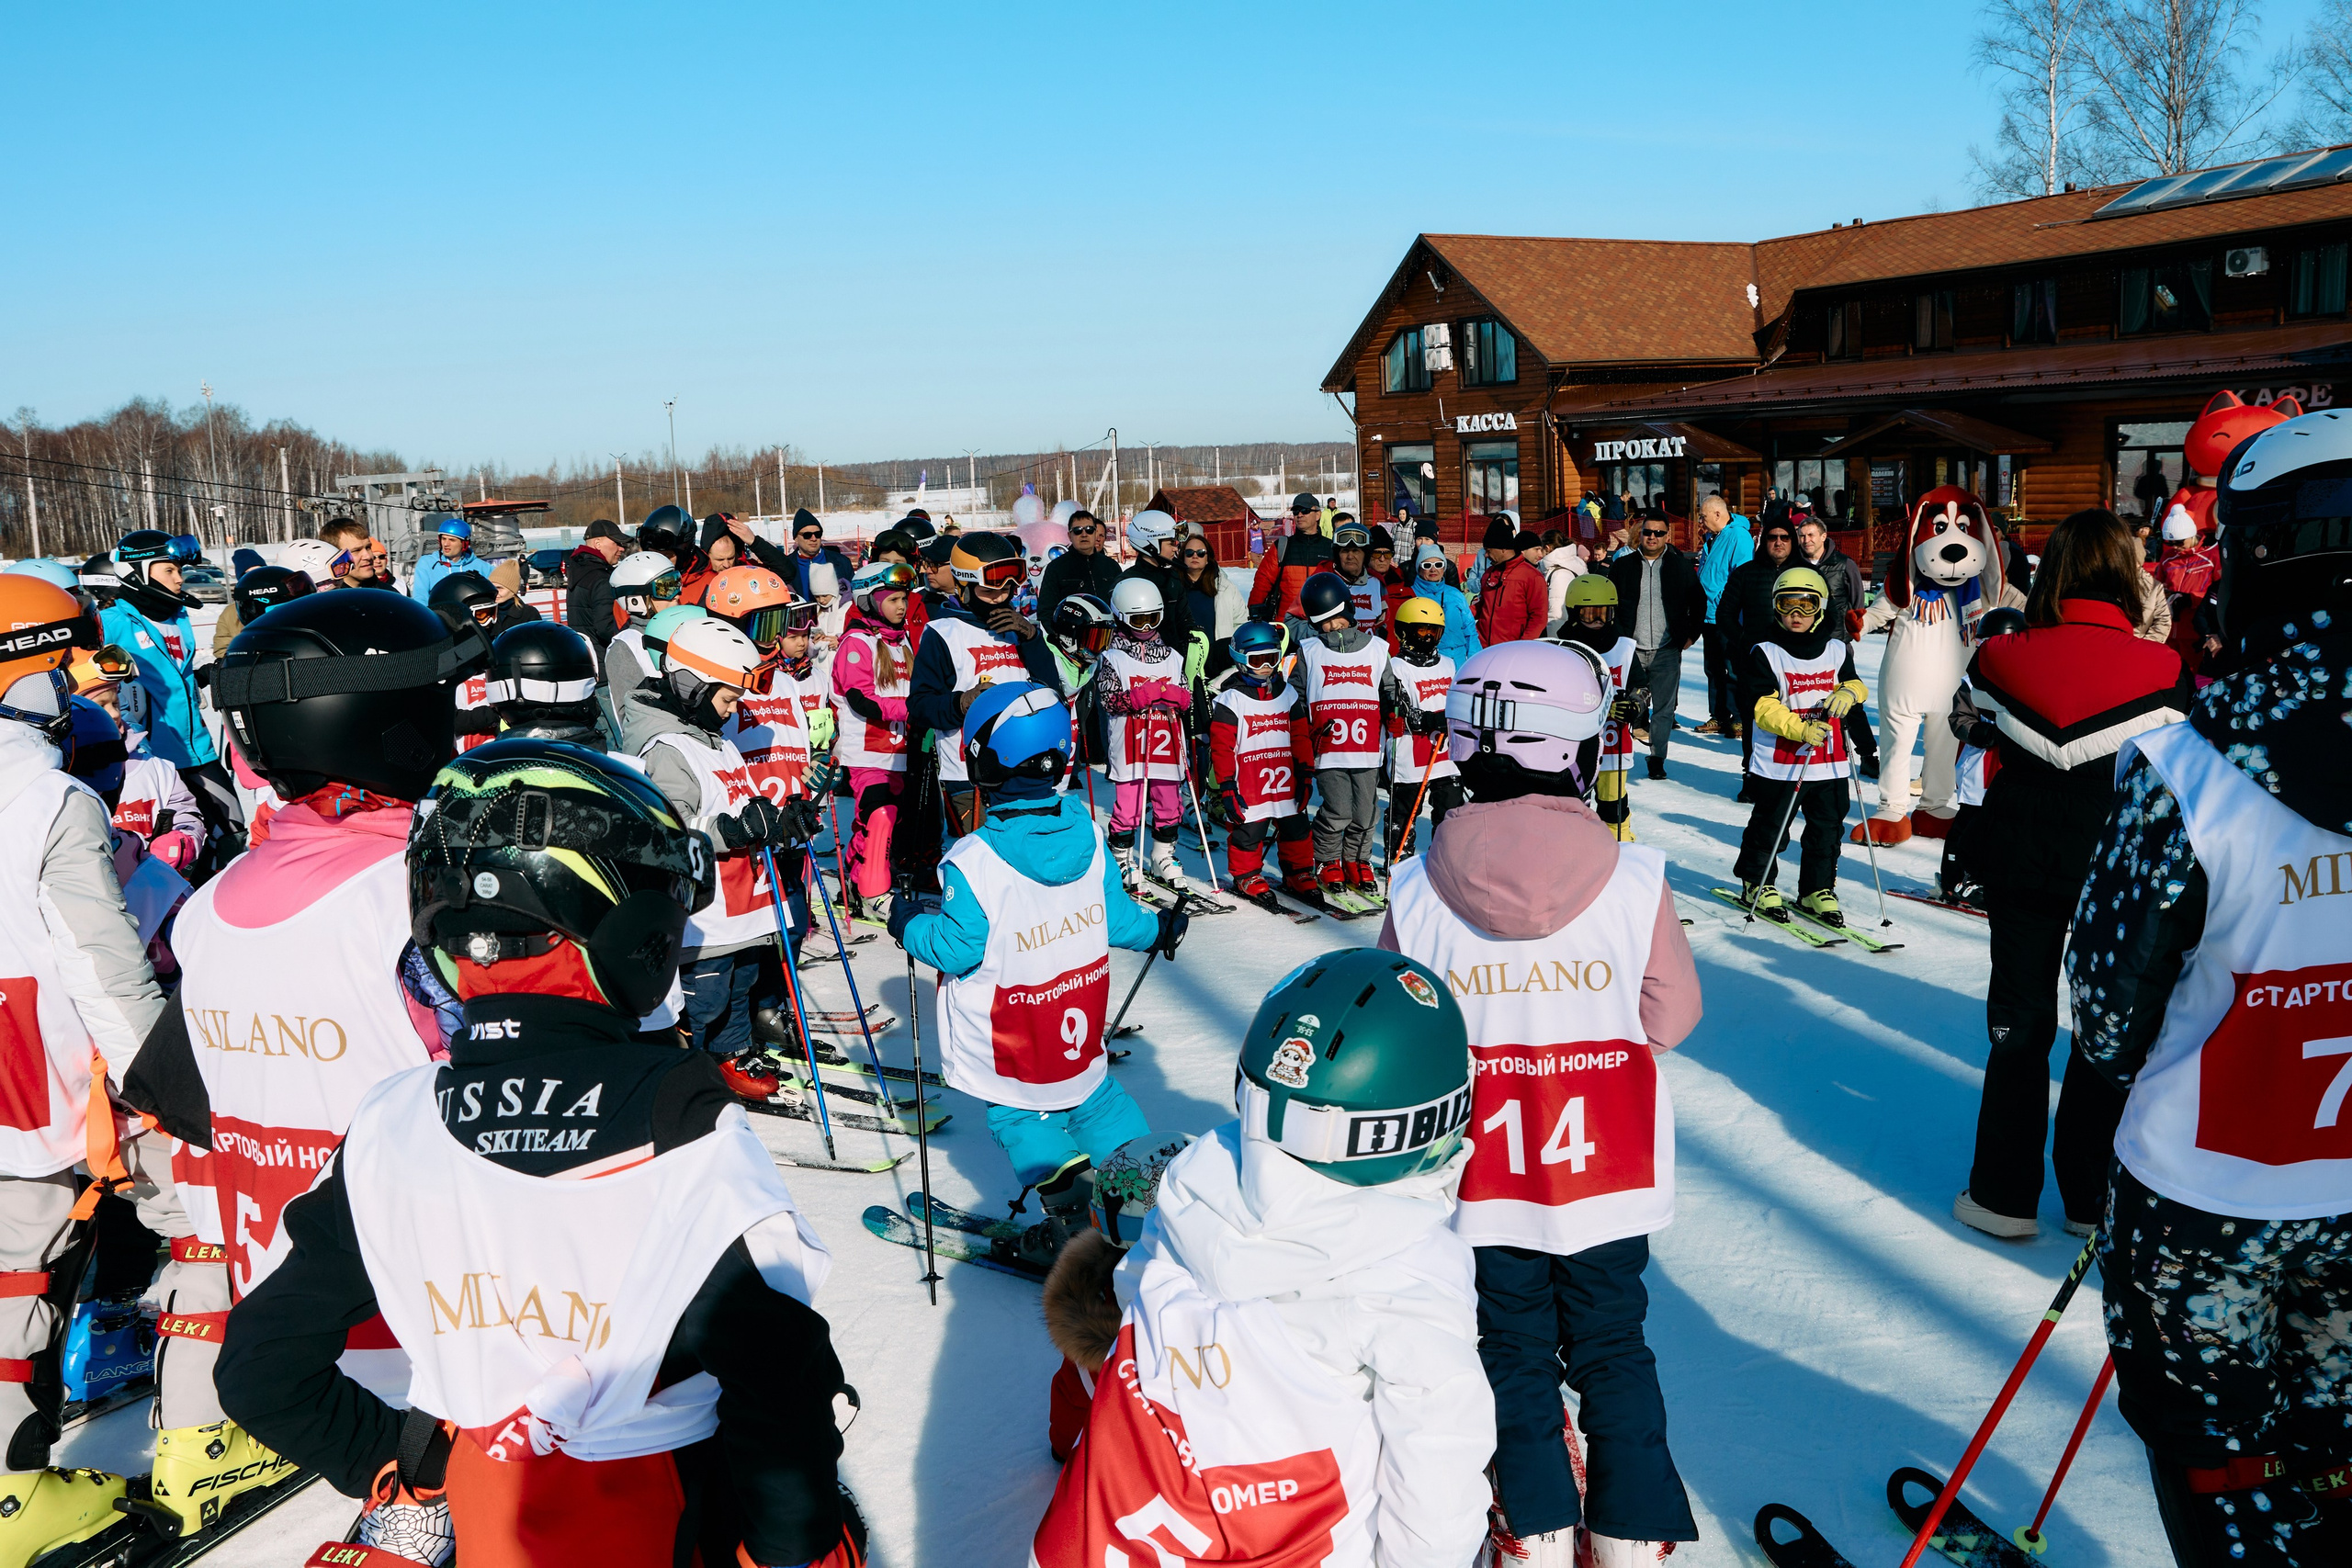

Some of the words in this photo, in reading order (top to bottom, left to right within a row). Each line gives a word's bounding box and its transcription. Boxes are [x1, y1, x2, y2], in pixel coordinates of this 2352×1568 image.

[1456, 412, 1517, 434] КАССА
[1594, 436, 1687, 461] ПРОКАТ
[125, 551, 155, 559] HEAD
[249, 586, 278, 596] HEAD
[979, 651, 1005, 665] Альфа
[1328, 671, 1351, 681] Альфа
[1351, 671, 1368, 679] Банк
[1792, 679, 1815, 689] Альфа
[1815, 677, 1834, 685] Банк
[1316, 702, 1359, 712] СТАРТОВЫЙ
[1252, 718, 1274, 730] Альфа
[1273, 717, 1288, 726] Банк
[1330, 717, 1368, 745] 96
[1136, 728, 1171, 756] 12
[1243, 750, 1282, 763] СТАРТОВЫЙ
[1259, 765, 1292, 795] 22
[1014, 903, 1105, 953] MILANO
[1008, 974, 1084, 1005] СТАРТОВЫЙ
[1448, 960, 1612, 998] MILANO
[1060, 1007, 1090, 1062] 9
[1560, 1050, 1629, 1073] НОМЕР
[1483, 1096, 1596, 1176] 14
[161, 1317, 211, 1337] LEKI
[321, 1547, 368, 1568] LEKI
